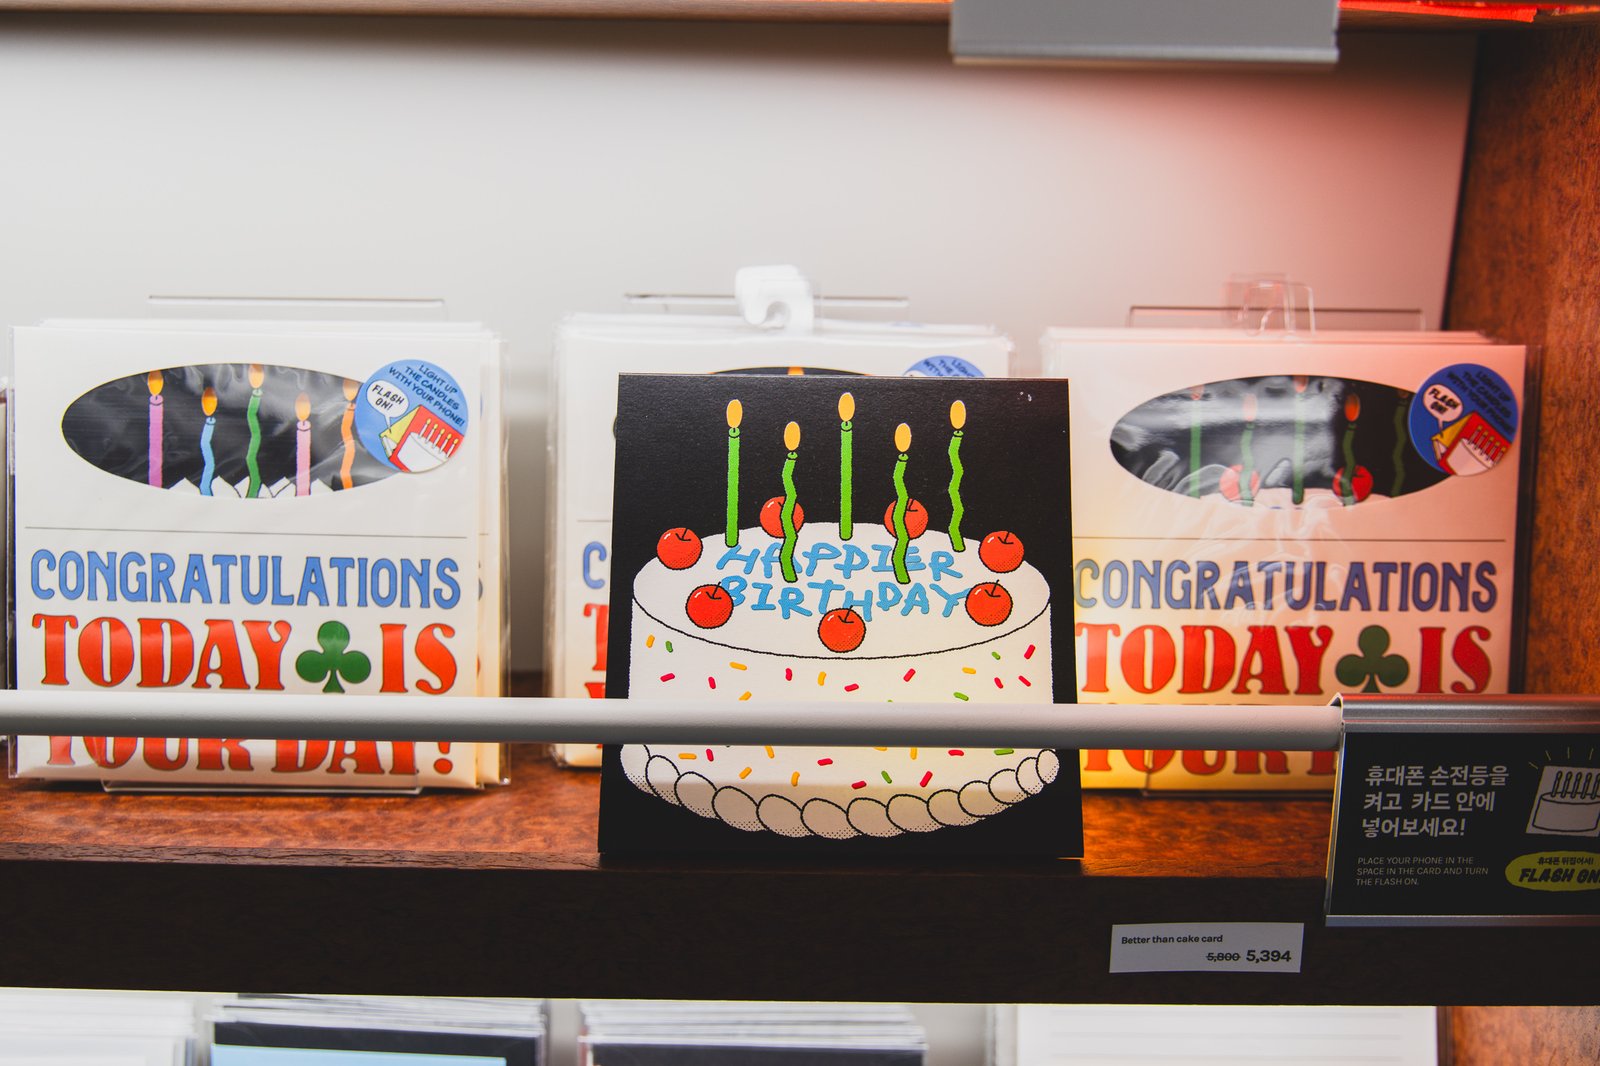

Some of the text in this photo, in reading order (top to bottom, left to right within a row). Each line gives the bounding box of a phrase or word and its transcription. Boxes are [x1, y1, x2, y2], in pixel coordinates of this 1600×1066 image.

[405, 366, 460, 410] THE CANDLES
[419, 365, 458, 394] LIGHT UP
[372, 385, 405, 405] FLASH
[375, 398, 392, 411] ON!
[389, 367, 465, 427] WITH YOUR PHONE!
[31, 549, 461, 609] CONGRATULATIONS
[1075, 558, 1498, 613] CONGRATULATIONS
[721, 575, 971, 622] BIRTHDAY
[32, 613, 458, 695] TODAY IS
[1076, 623, 1492, 695] TODAY IS
[1365, 765, 1509, 786] 휴대폰 손전등을
[1363, 791, 1496, 812] 켜고 카드 안에
[1362, 817, 1466, 838] 넣어보세요!
[1358, 857, 1384, 865] PLACE
[1387, 857, 1411, 865] YOUR
[1412, 857, 1443, 865] PHONE
[1356, 878, 1419, 886] THE FLASH ON.
[1357, 868, 1384, 876] SPACE
[1519, 868, 1600, 884] FLASH ON
[1121, 935, 1223, 944] Better than cake card
[1206, 950, 1292, 964] 5,800 5,394
